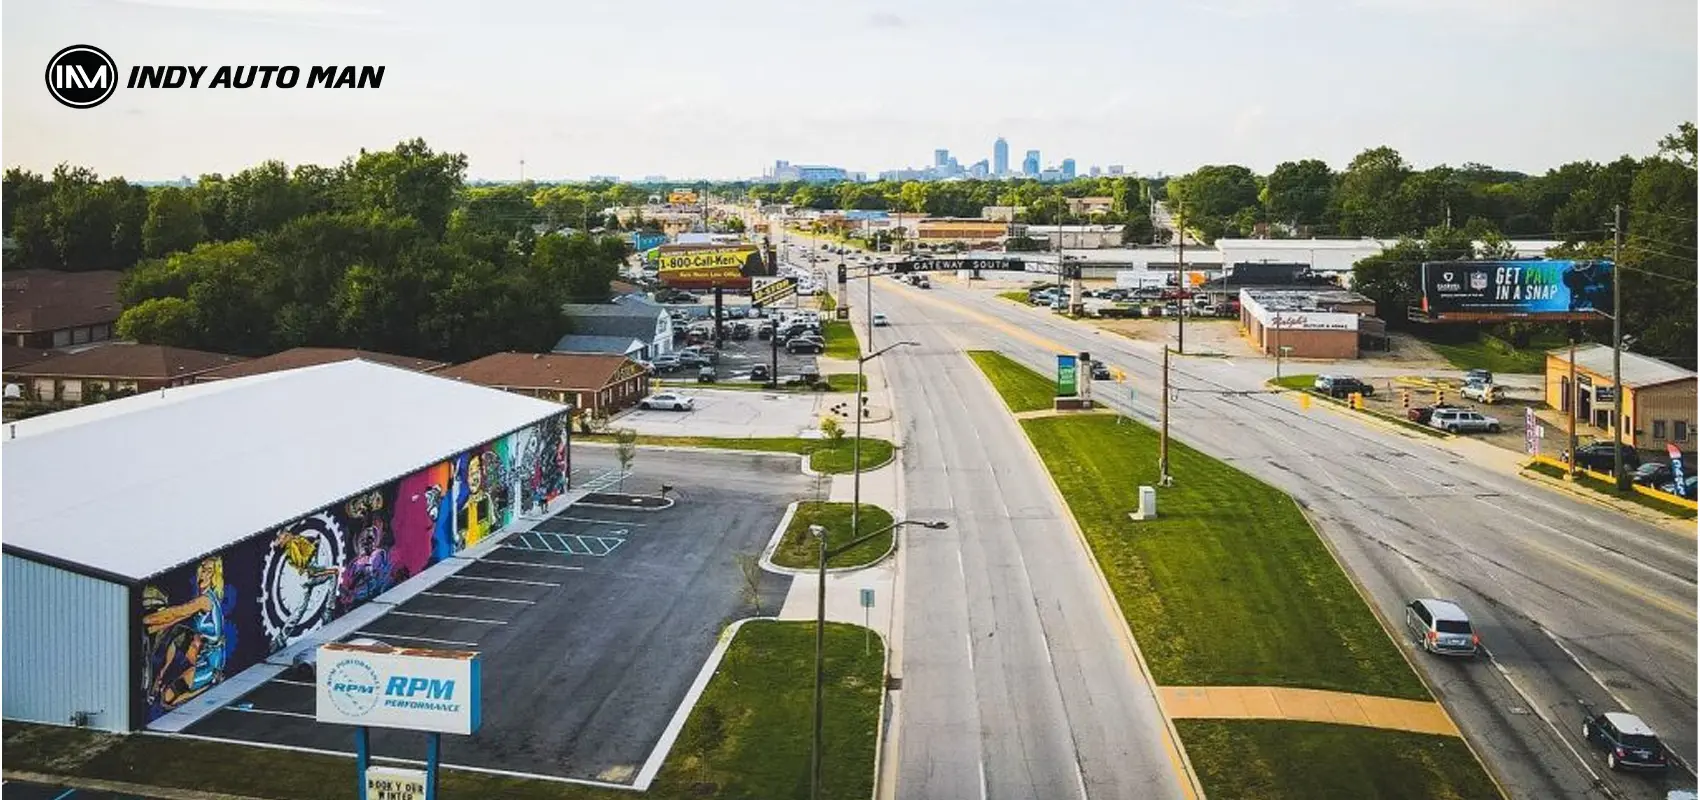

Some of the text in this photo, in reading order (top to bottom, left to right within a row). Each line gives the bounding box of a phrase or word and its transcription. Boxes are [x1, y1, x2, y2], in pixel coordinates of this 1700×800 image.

[660, 255, 735, 269] 1-800-Call-Ken
[913, 260, 1009, 271] GATEWAY SOUTH
[1495, 267, 1522, 285] GET
[1495, 285, 1558, 300] IN A SNAP
[333, 682, 375, 694] RPM
[384, 675, 456, 700] RPM
[383, 699, 461, 713] PERFORMANCE
[368, 780, 393, 792] BOOK
